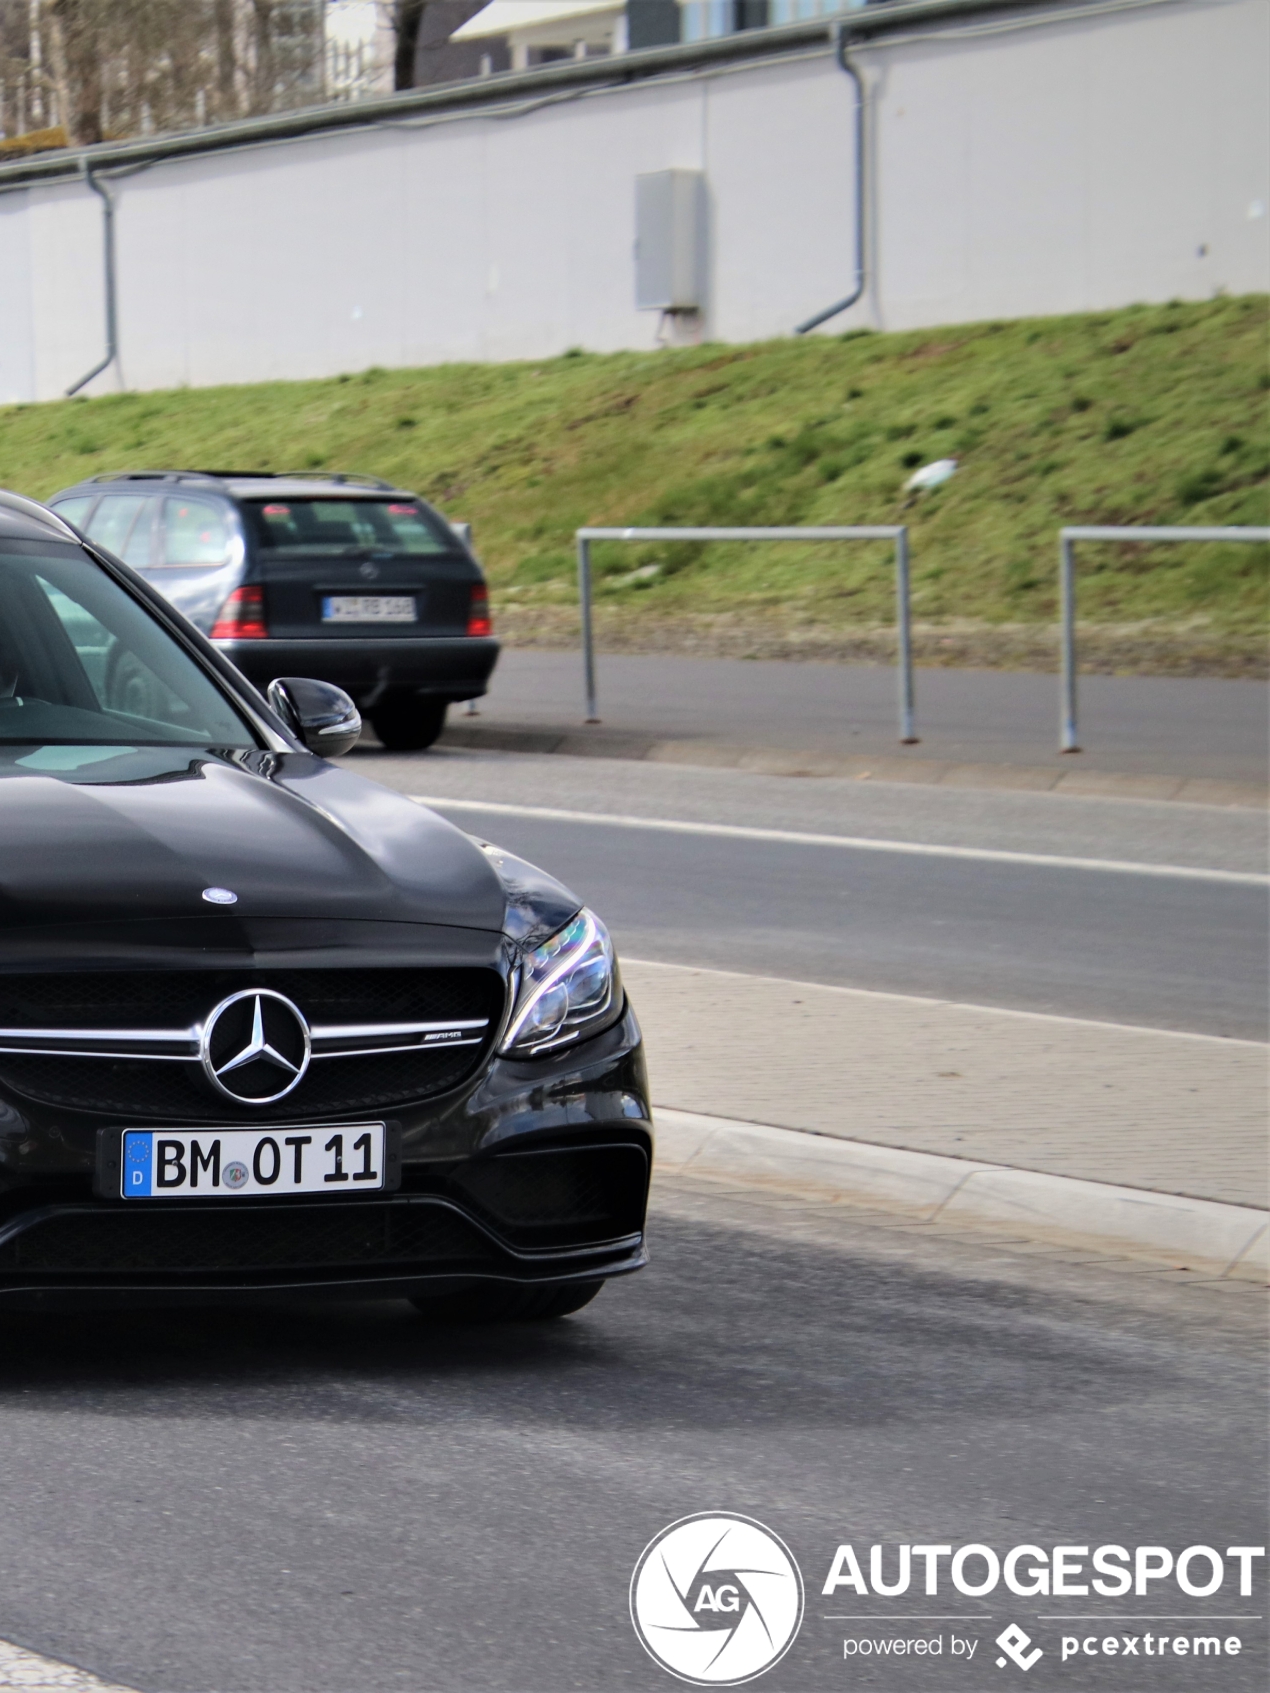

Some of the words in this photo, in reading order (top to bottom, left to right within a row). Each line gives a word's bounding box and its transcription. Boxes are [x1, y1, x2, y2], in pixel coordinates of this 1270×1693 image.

[156, 1139, 221, 1187] BM
[253, 1136, 312, 1185] OT
[324, 1132, 377, 1183] 11
[132, 1170, 143, 1185] D
